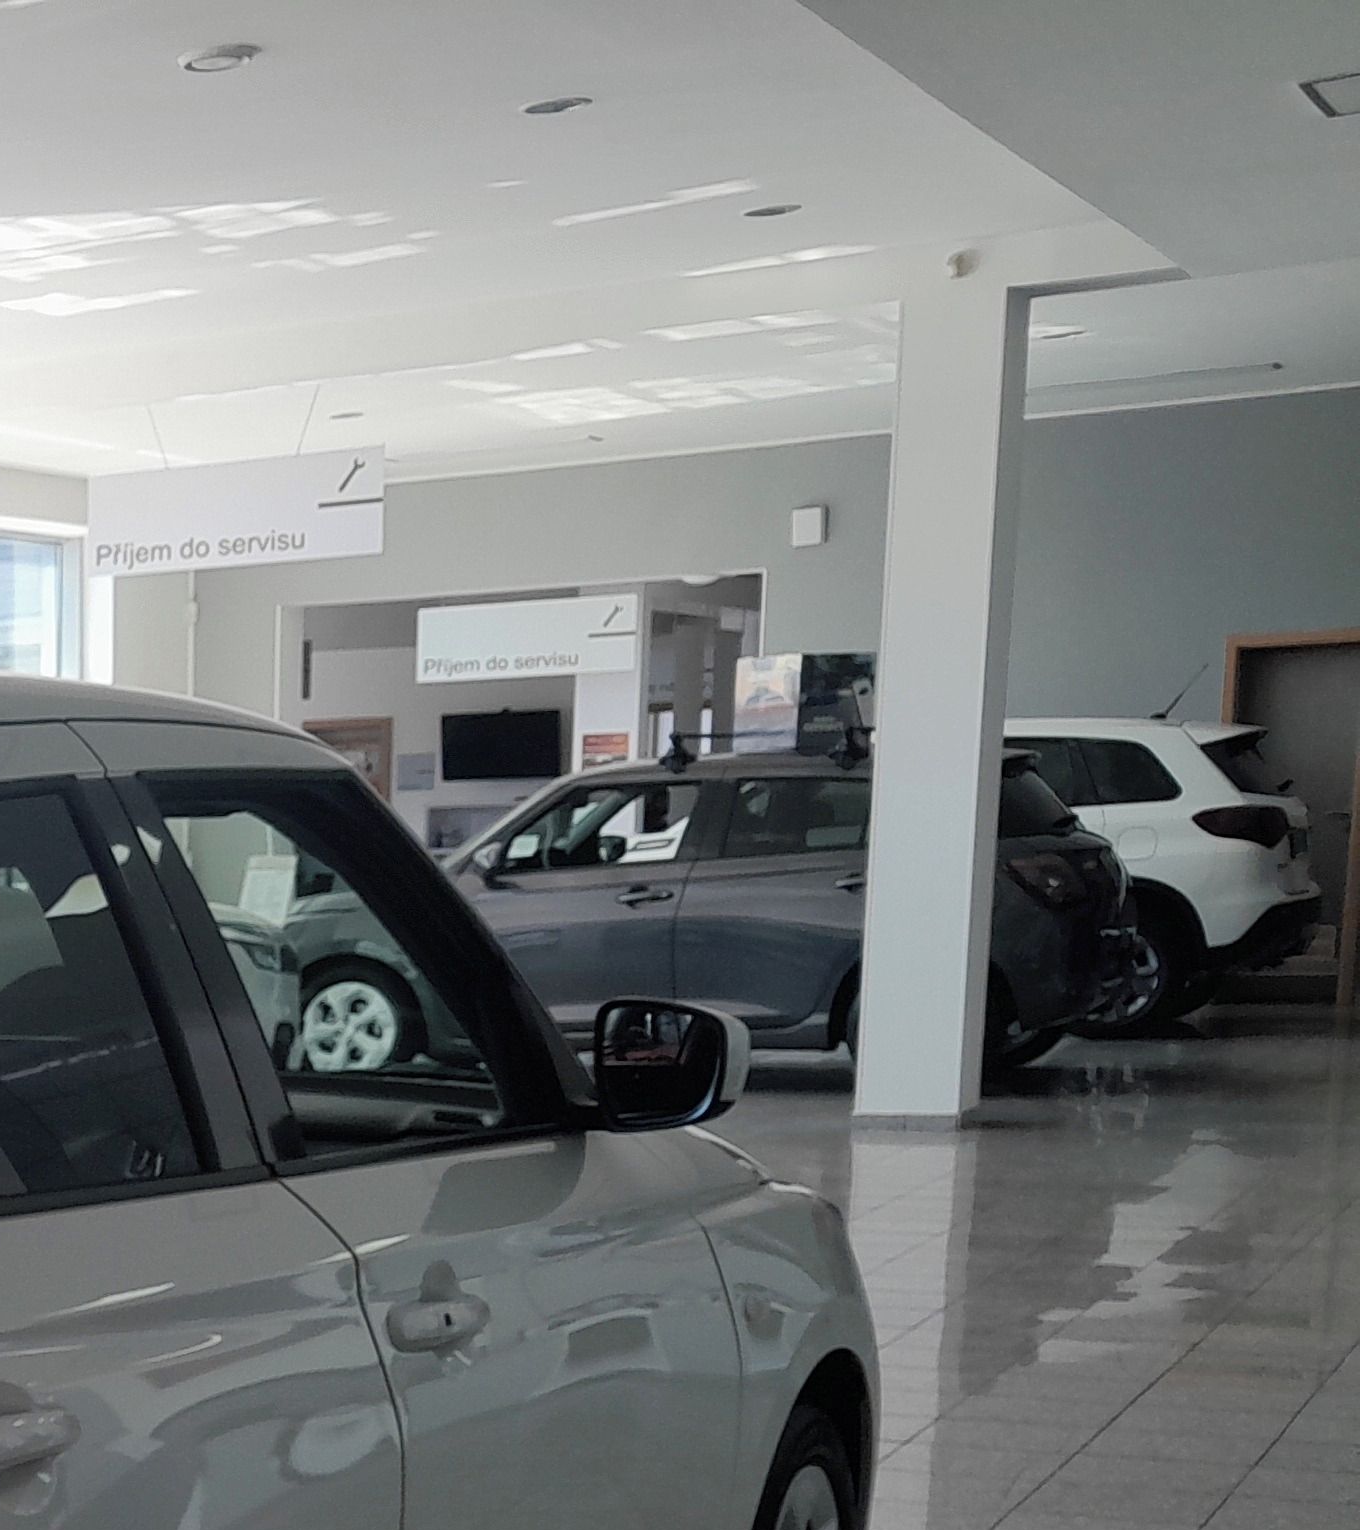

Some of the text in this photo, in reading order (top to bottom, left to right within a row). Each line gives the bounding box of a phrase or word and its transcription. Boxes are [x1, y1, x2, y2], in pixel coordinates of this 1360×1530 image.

[95, 529, 306, 570] Příjem do servisu
[485, 655, 509, 671] do
[514, 651, 579, 670] servisu
